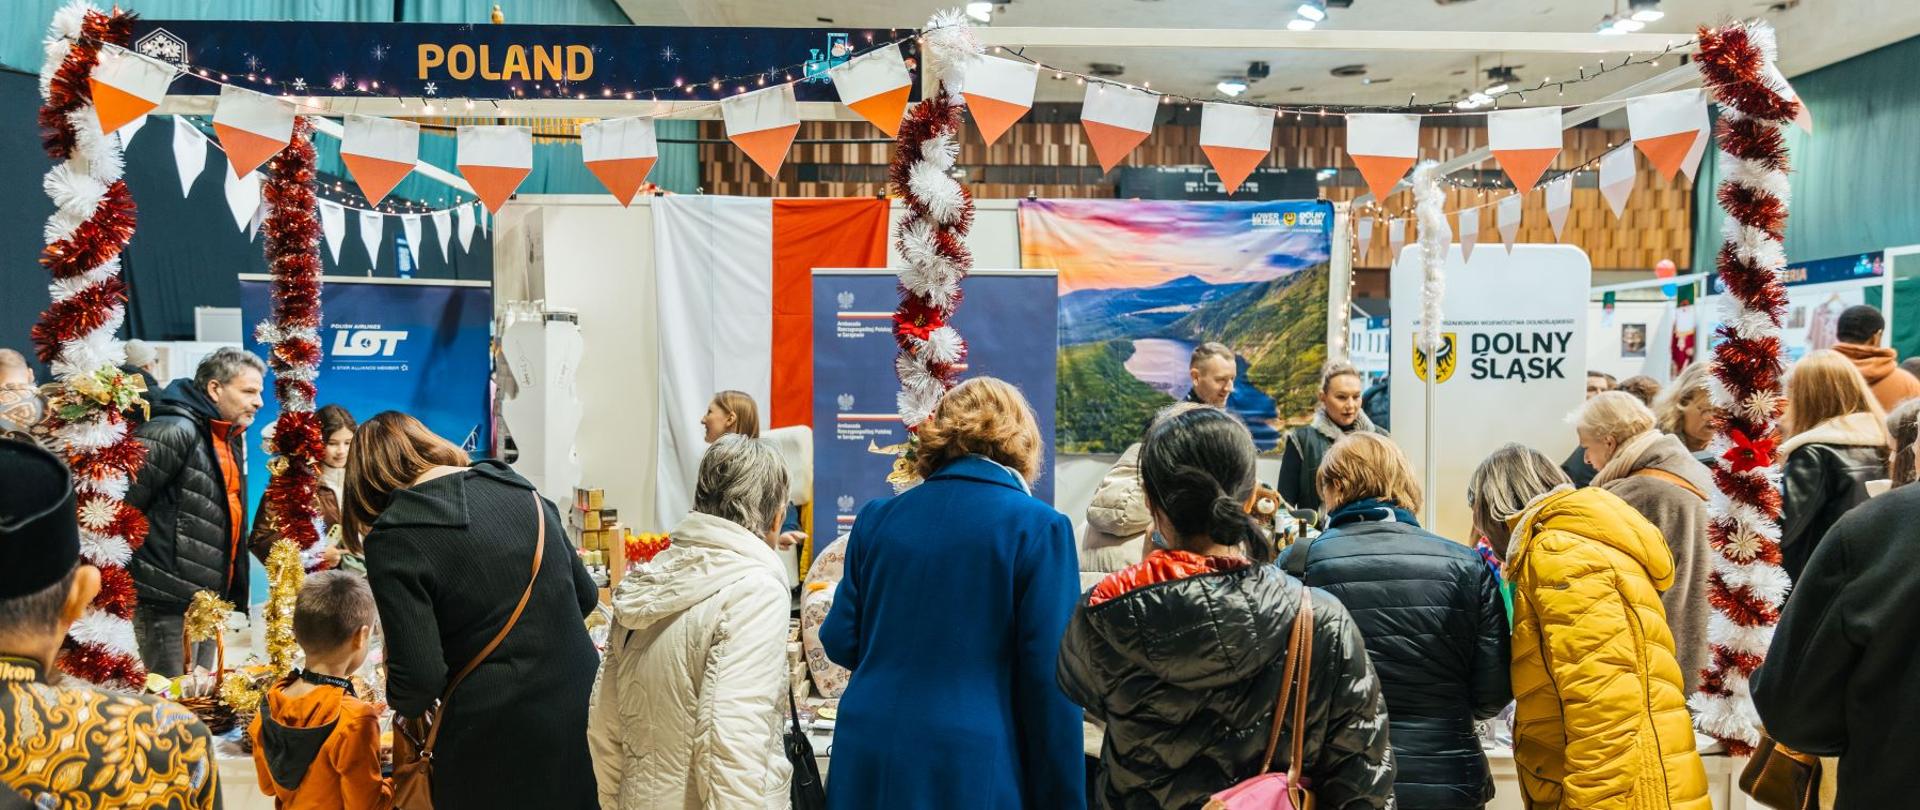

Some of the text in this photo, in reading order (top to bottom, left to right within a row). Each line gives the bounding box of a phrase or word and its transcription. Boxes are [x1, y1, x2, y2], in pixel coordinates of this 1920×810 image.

[417, 43, 594, 81] POLAND
[331, 330, 408, 356] LOT
[1472, 331, 1573, 354] DOLNY
[1471, 353, 1566, 383] ŚLĄSK
